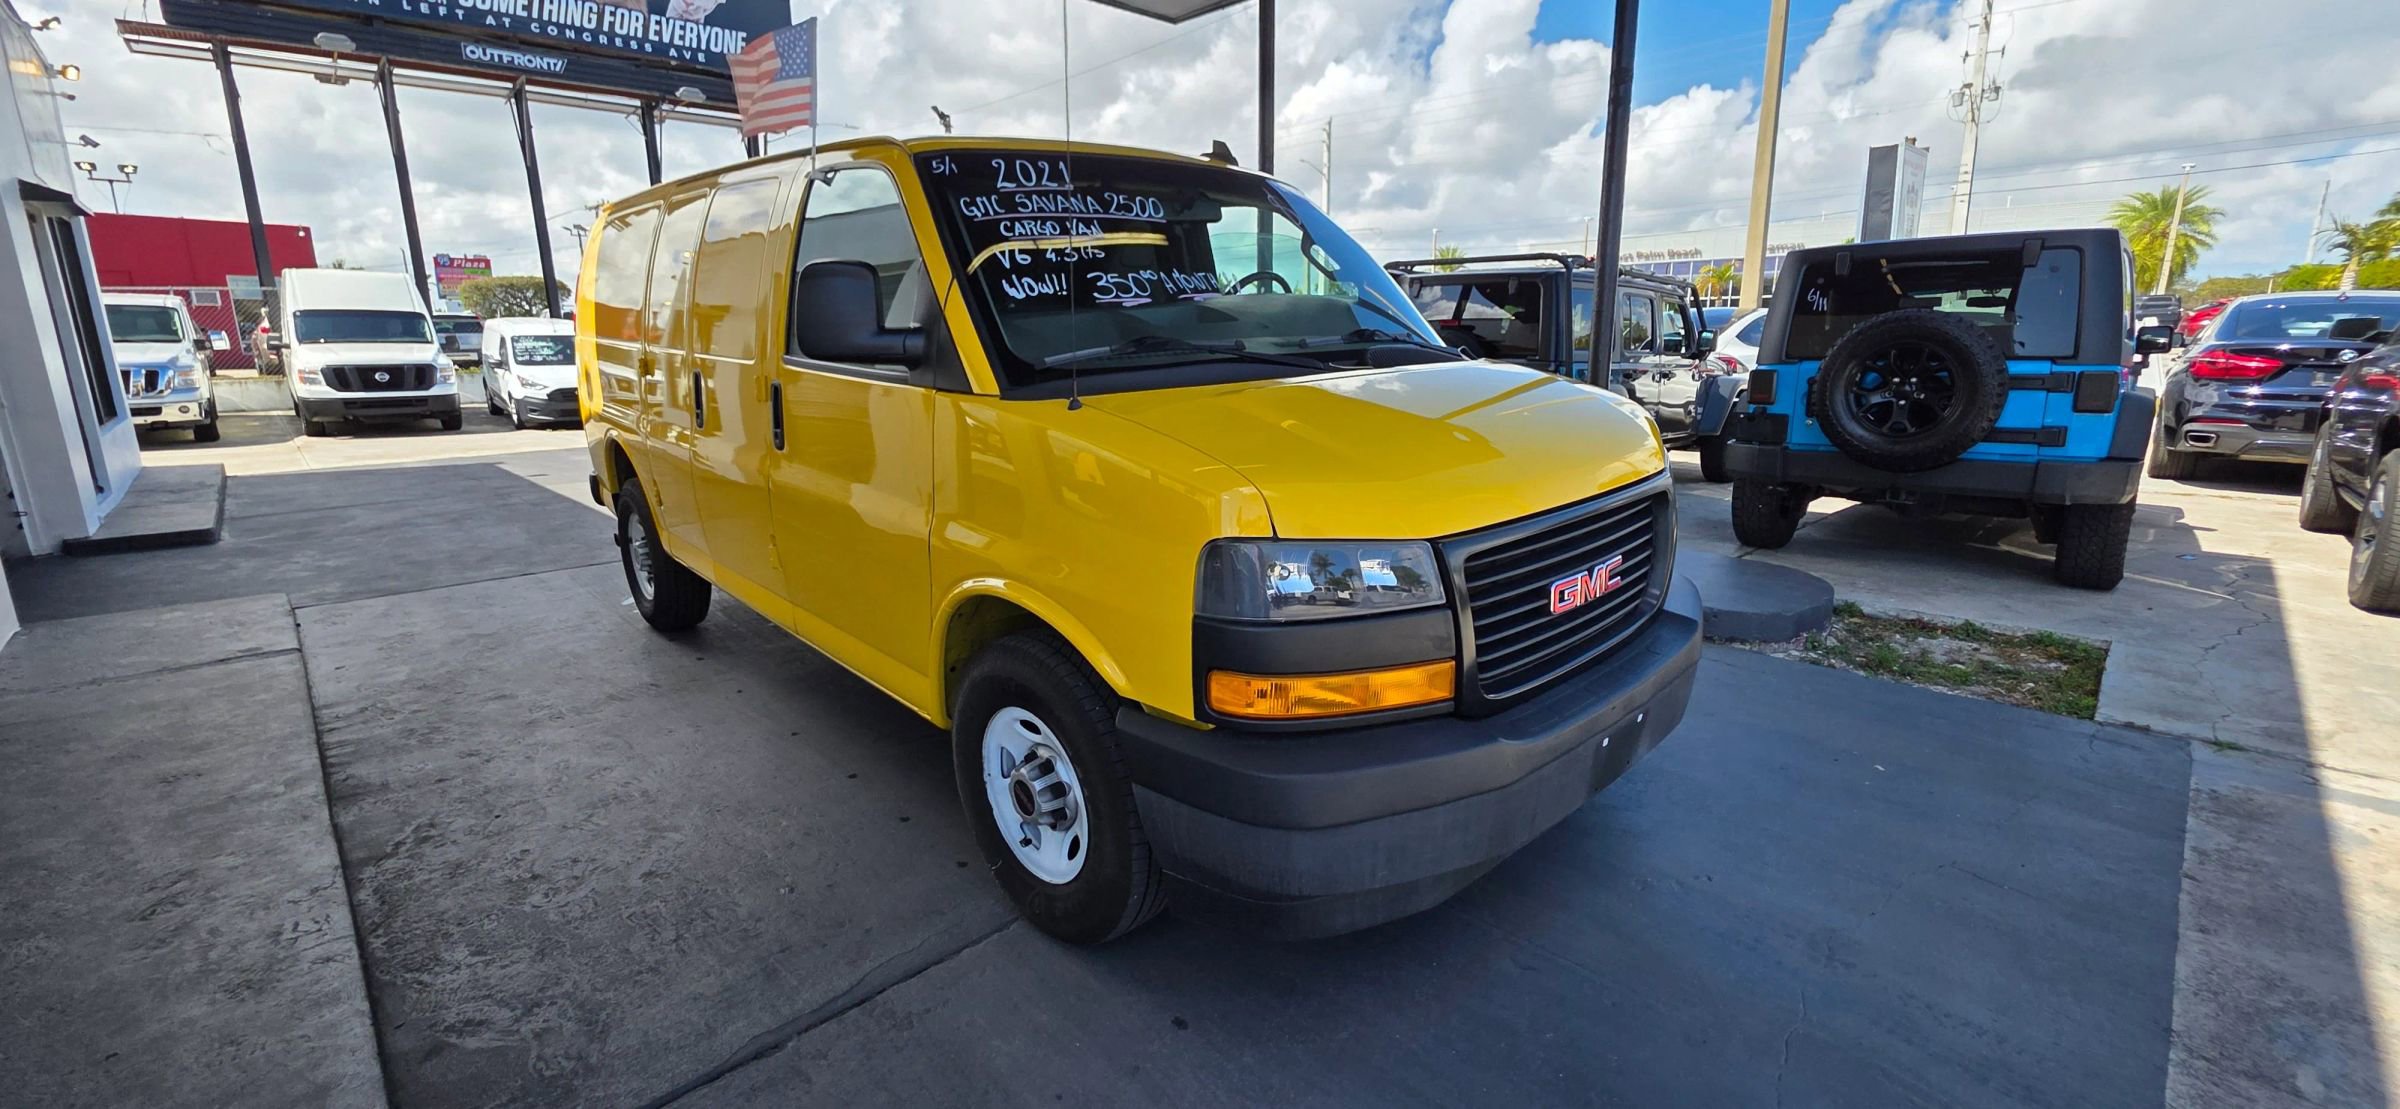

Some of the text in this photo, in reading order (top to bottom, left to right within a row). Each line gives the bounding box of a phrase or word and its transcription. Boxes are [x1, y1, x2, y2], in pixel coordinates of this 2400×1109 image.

[402, 0, 706, 63] LEFT AT CONGRESS AVE
[603, 6, 644, 38] FOR
[992, 159, 1072, 189] 2021
[960, 192, 1164, 218] GMC SAVANA 2500
[1000, 219, 1104, 239] CARGO VAN
[453, 259, 486, 268] Plaza
[995, 245, 1032, 269] V6
[1807, 287, 1828, 311] 6/11
[1550, 554, 1623, 615] GMC
